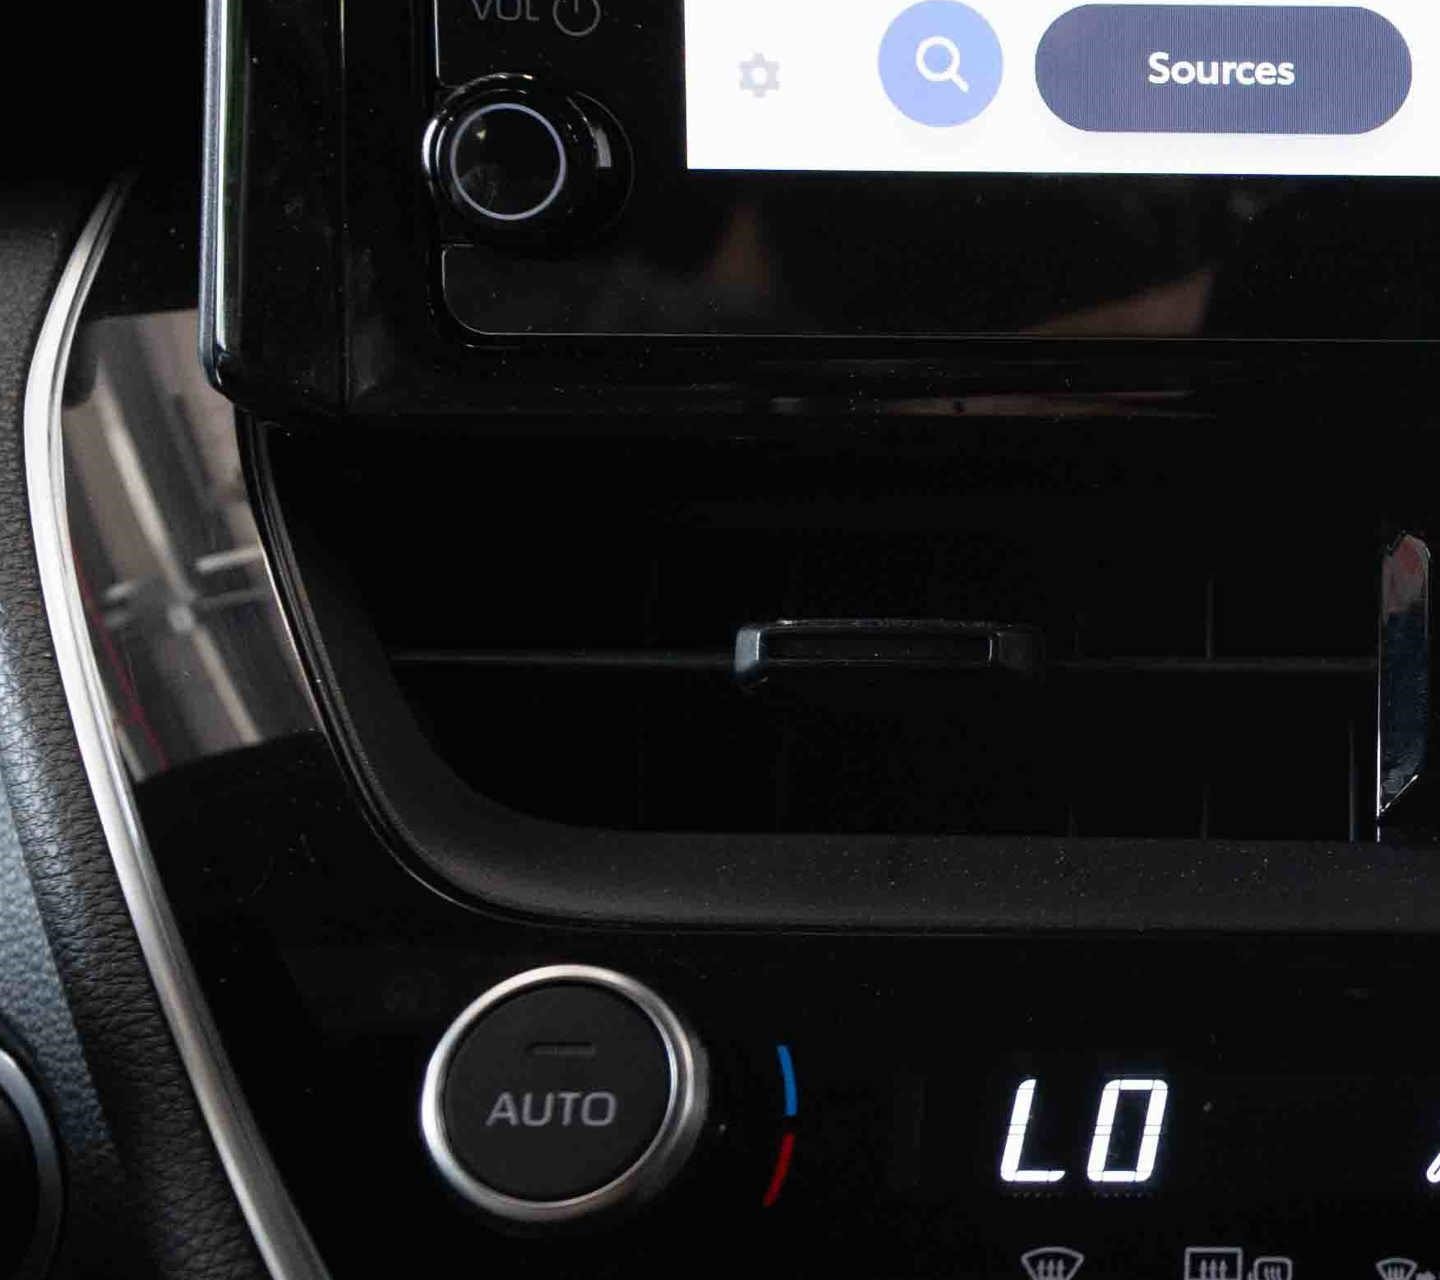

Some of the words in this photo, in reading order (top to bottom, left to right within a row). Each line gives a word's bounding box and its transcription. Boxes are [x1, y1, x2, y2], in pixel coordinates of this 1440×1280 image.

[1147, 51, 1296, 86] Sources
[485, 1090, 618, 1128] AUTO
[1000, 1077, 1169, 1183] LO
